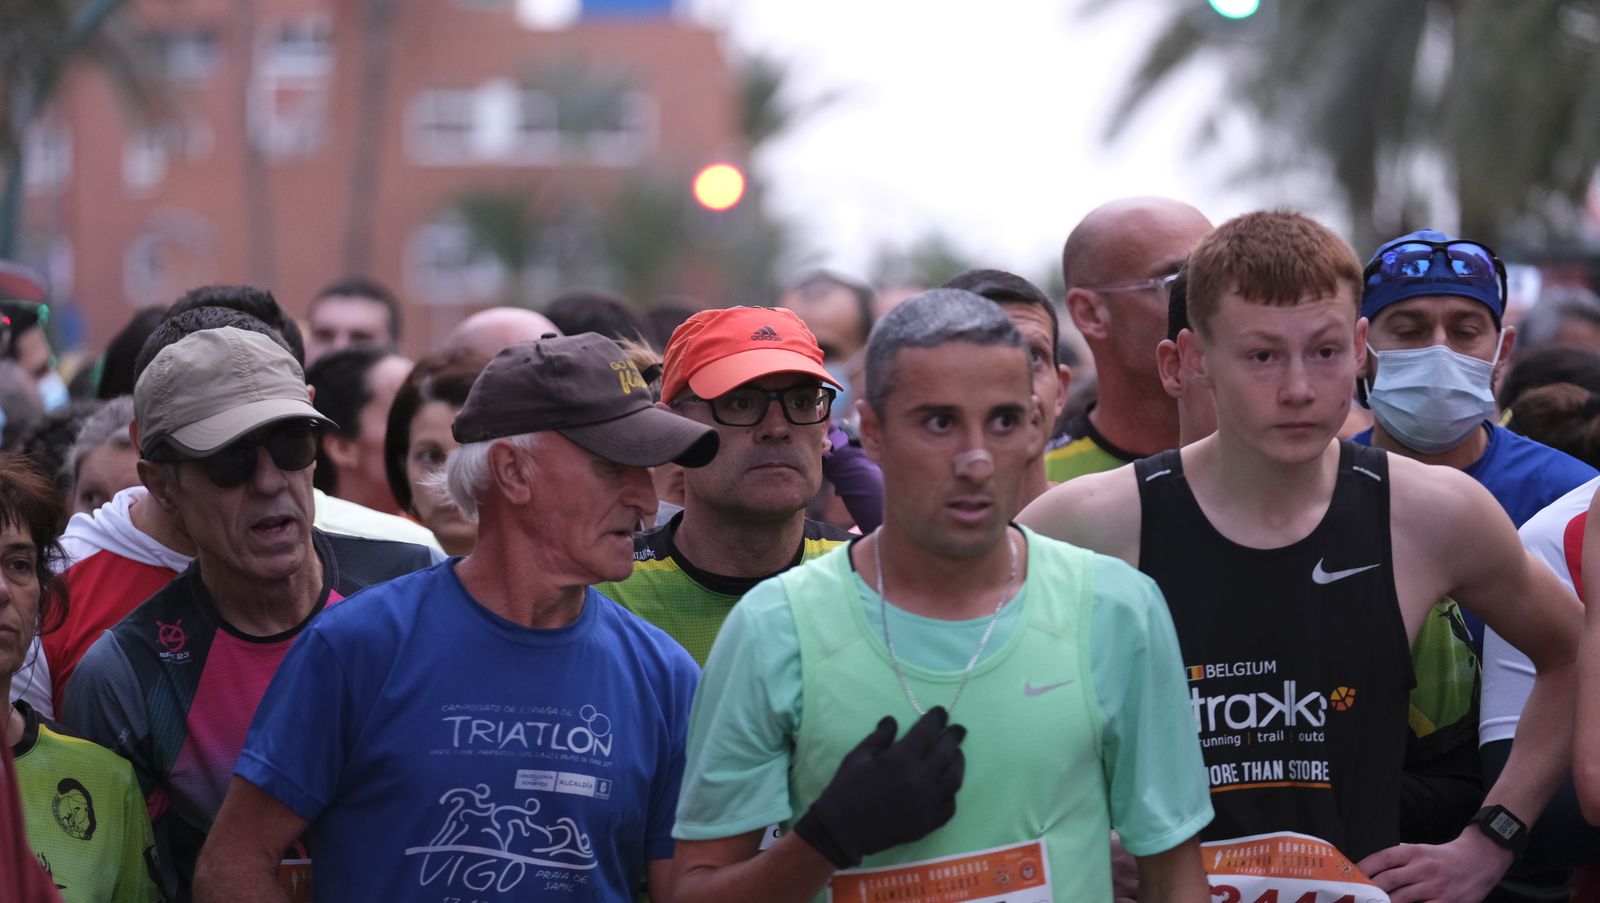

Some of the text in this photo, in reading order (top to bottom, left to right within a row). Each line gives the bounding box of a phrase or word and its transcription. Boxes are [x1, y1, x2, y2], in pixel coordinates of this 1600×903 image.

[1206, 660, 1277, 679] BELGIUM
[441, 715, 613, 758] TRIATLON
[1198, 733, 1241, 747] unning
[1258, 730, 1284, 743] trail
[1207, 760, 1330, 785] ORE THAN STORE
[1277, 841, 1334, 857] BOMBEROS
[420, 853, 526, 892] VIGO
[535, 870, 591, 884] PRAIA DE
[543, 882, 575, 892] SAMIL
